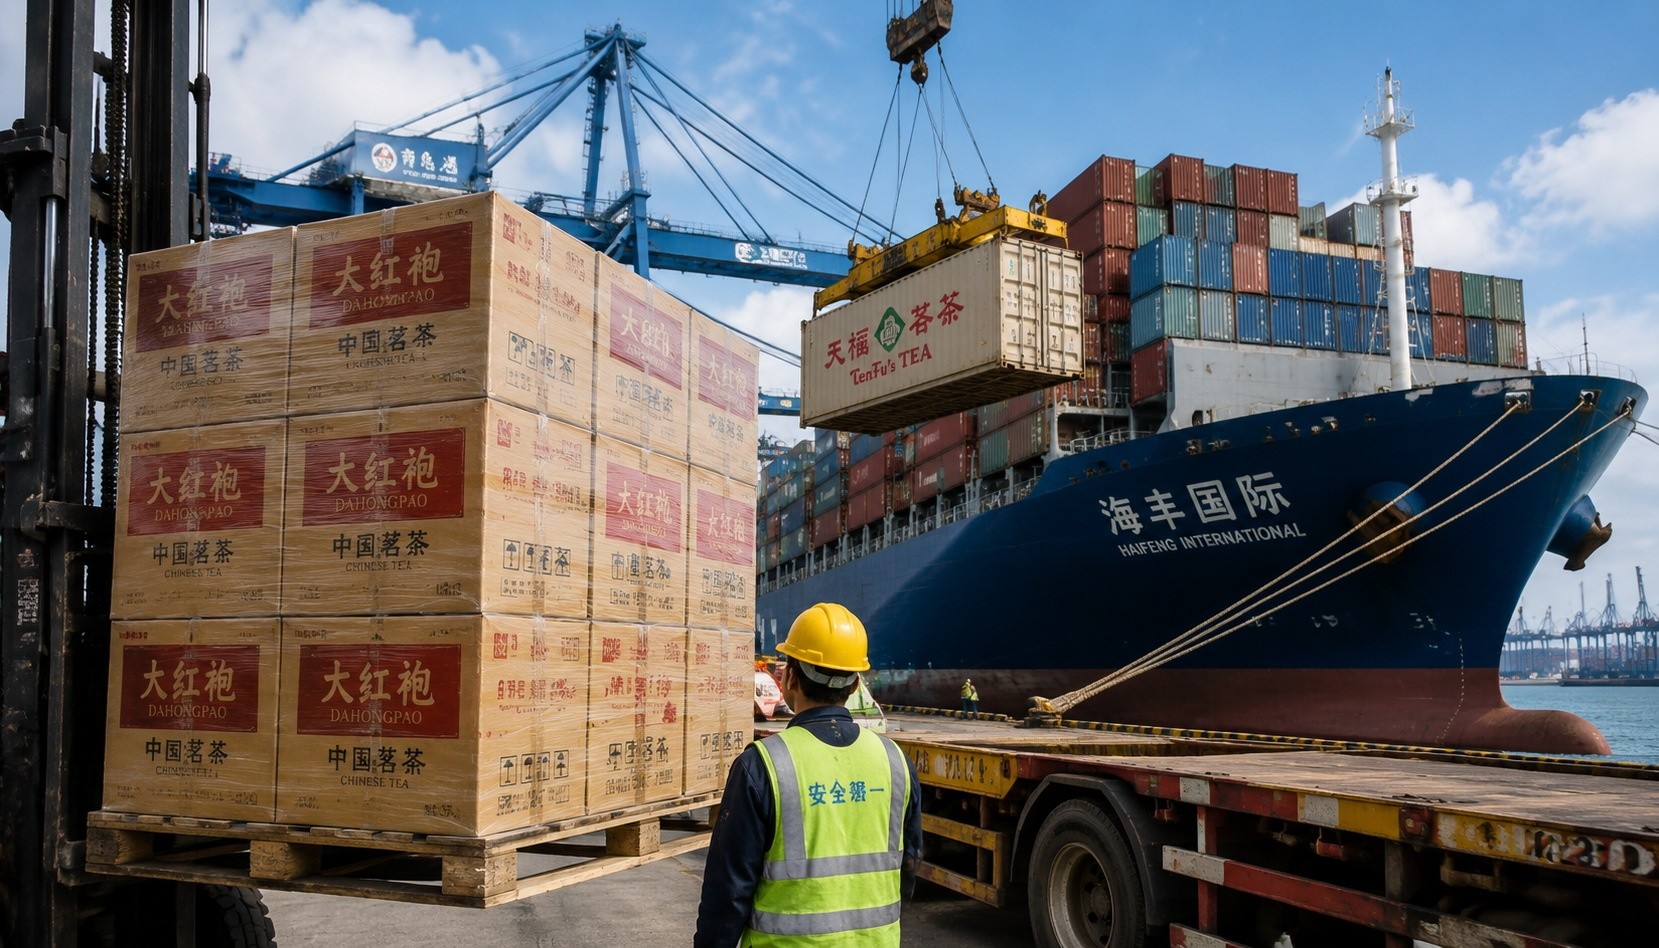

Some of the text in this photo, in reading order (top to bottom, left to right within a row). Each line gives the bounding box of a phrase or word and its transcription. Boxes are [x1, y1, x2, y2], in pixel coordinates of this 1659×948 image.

[332, 241, 444, 297] 大红袍
[155, 273, 248, 323] 大红袍
[338, 322, 437, 358] 中国茗茶
[824, 327, 870, 369] 天福
[849, 343, 933, 386] TenFu's TEA
[146, 461, 242, 506] 大红袍
[325, 446, 438, 495] 大红袍
[335, 494, 428, 512] DAHONGPAO
[1098, 470, 1291, 536] 海丰国际
[152, 537, 235, 566] 中国茗茶
[332, 529, 430, 560] 中国茗茶
[1117, 522, 1308, 558] HAIFENG INTERNATIONAL
[139, 658, 237, 702] 大红袍
[321, 658, 436, 707] 大红袍
[148, 703, 227, 719] DAHONGPAO
[330, 708, 423, 725] DAHONGPAO
[145, 736, 228, 765] 中国茗茶
[328, 744, 427, 775] 中国茗茶
[340, 774, 410, 789] CHINESE TEA
